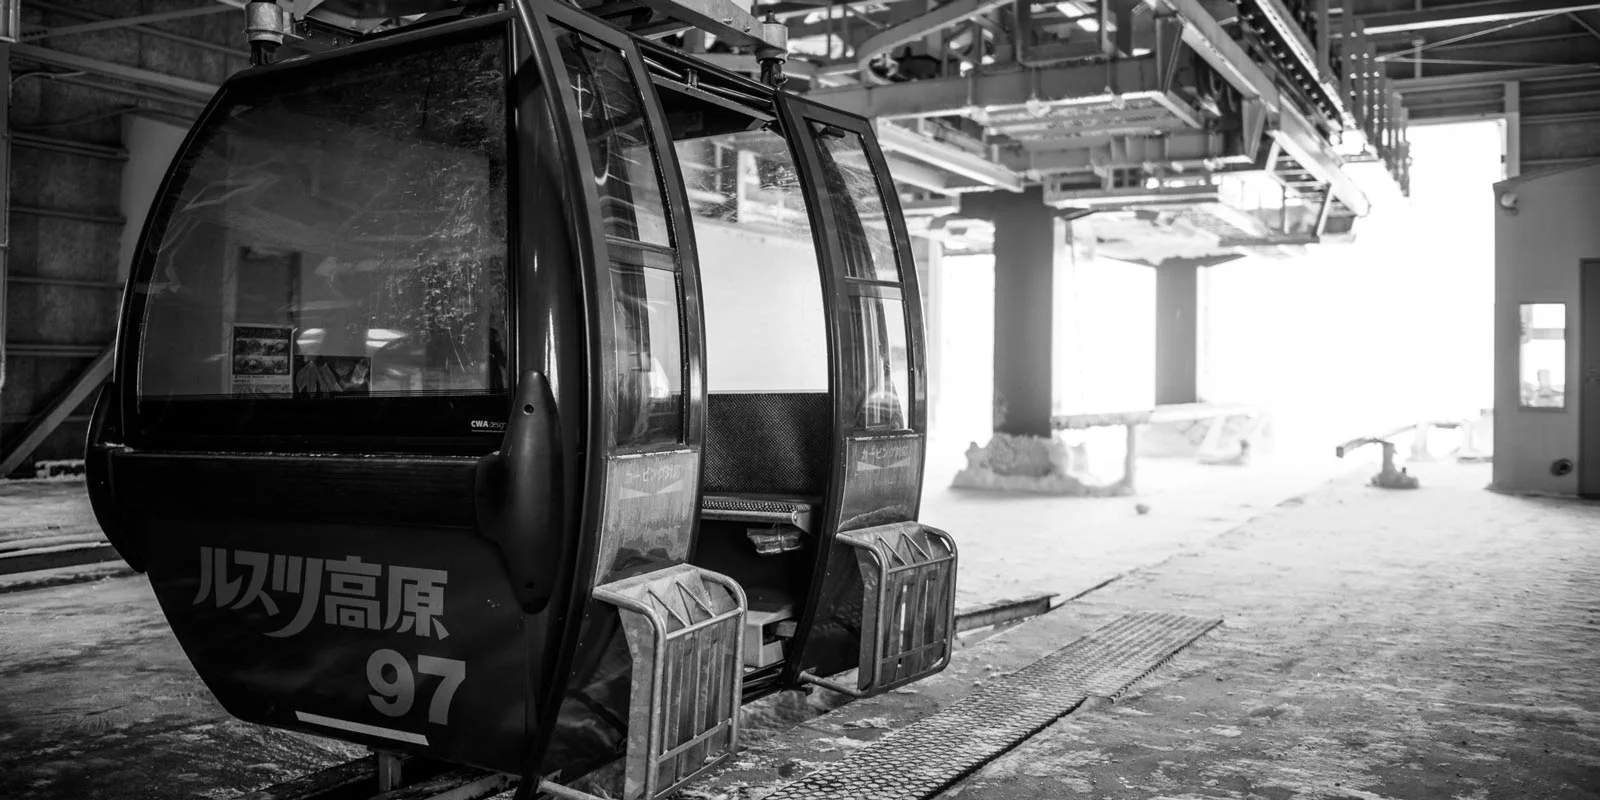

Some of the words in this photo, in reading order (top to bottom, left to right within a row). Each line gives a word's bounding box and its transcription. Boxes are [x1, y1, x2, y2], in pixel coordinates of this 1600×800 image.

[471, 420, 489, 428] CWA
[192, 546, 450, 640] ルスツ高原
[366, 648, 466, 725] 97
